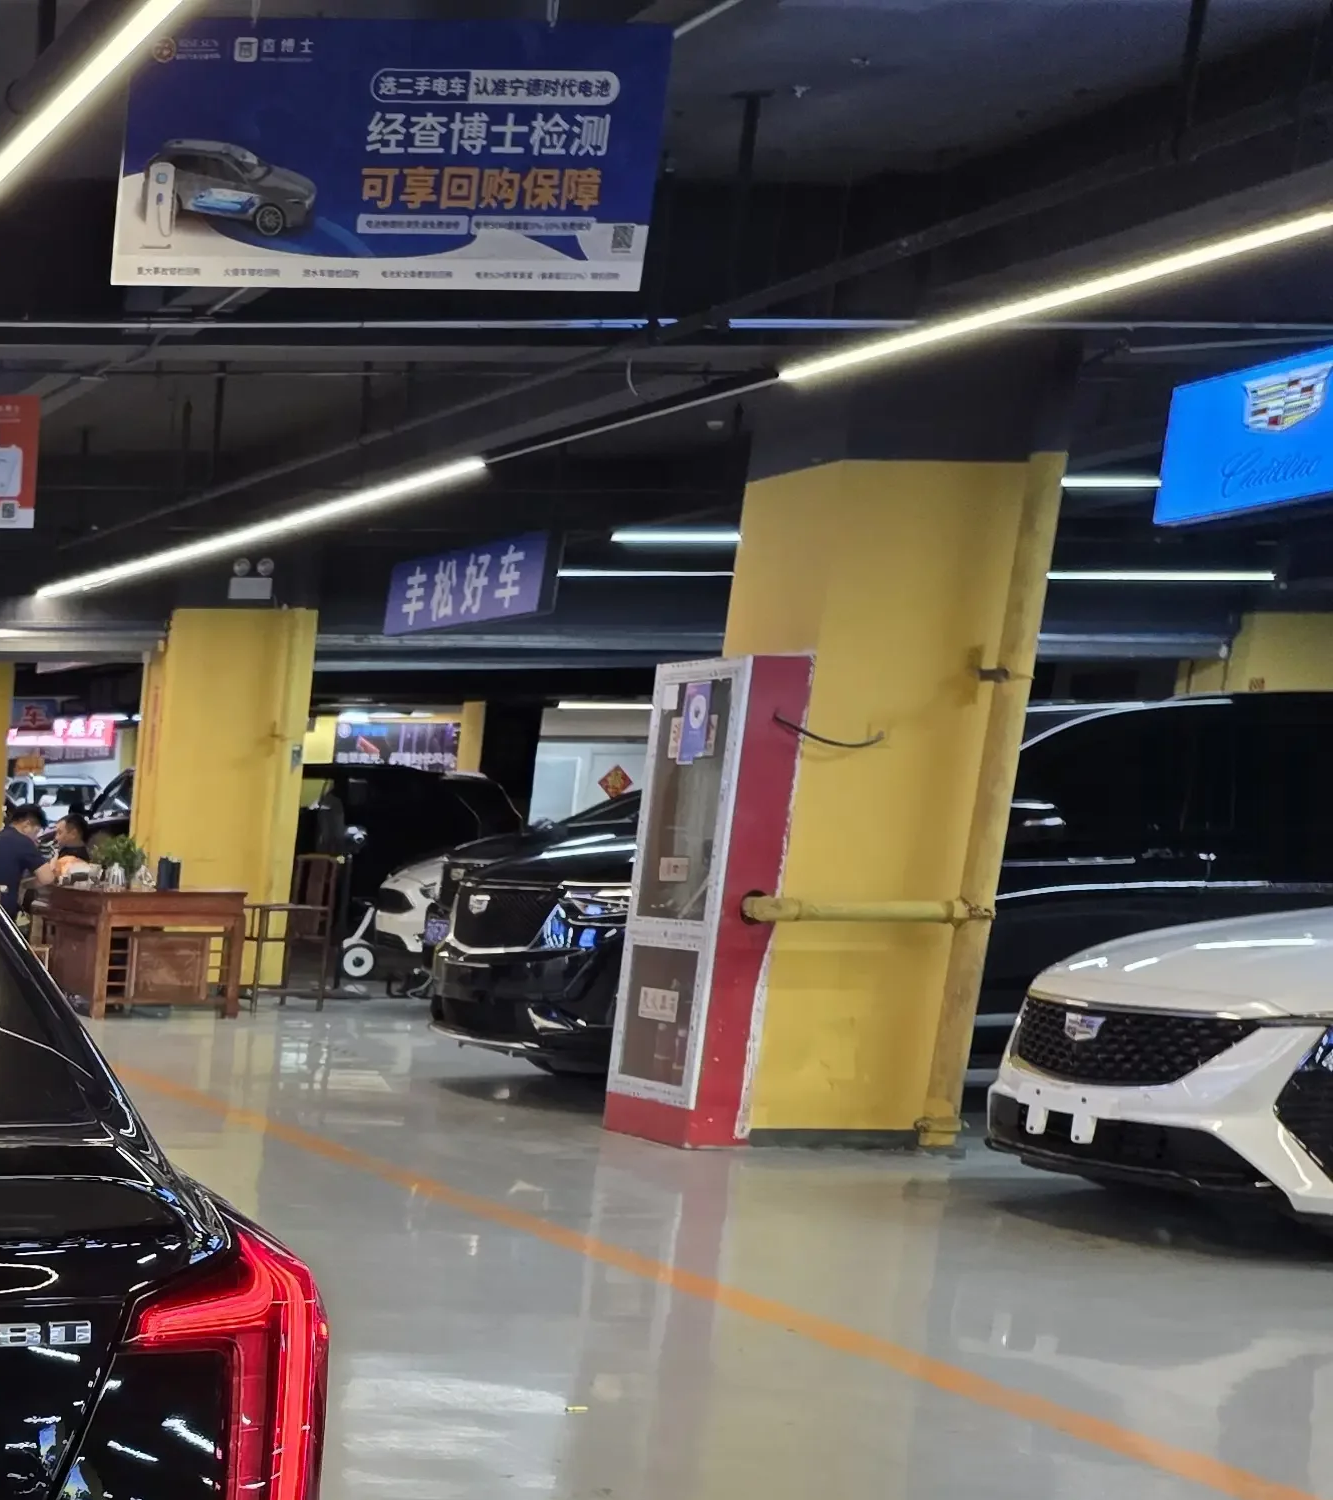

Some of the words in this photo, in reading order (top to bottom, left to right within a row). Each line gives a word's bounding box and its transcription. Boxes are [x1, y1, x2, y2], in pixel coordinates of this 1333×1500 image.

[379, 77, 466, 97] 选二手电车
[475, 78, 611, 98] 认准宁德时代电池
[366, 112, 610, 157] 经查博士检测
[360, 167, 601, 210] 可享回购保障
[1221, 448, 1322, 498] Cadillac
[402, 544, 525, 626] 丰松好车
